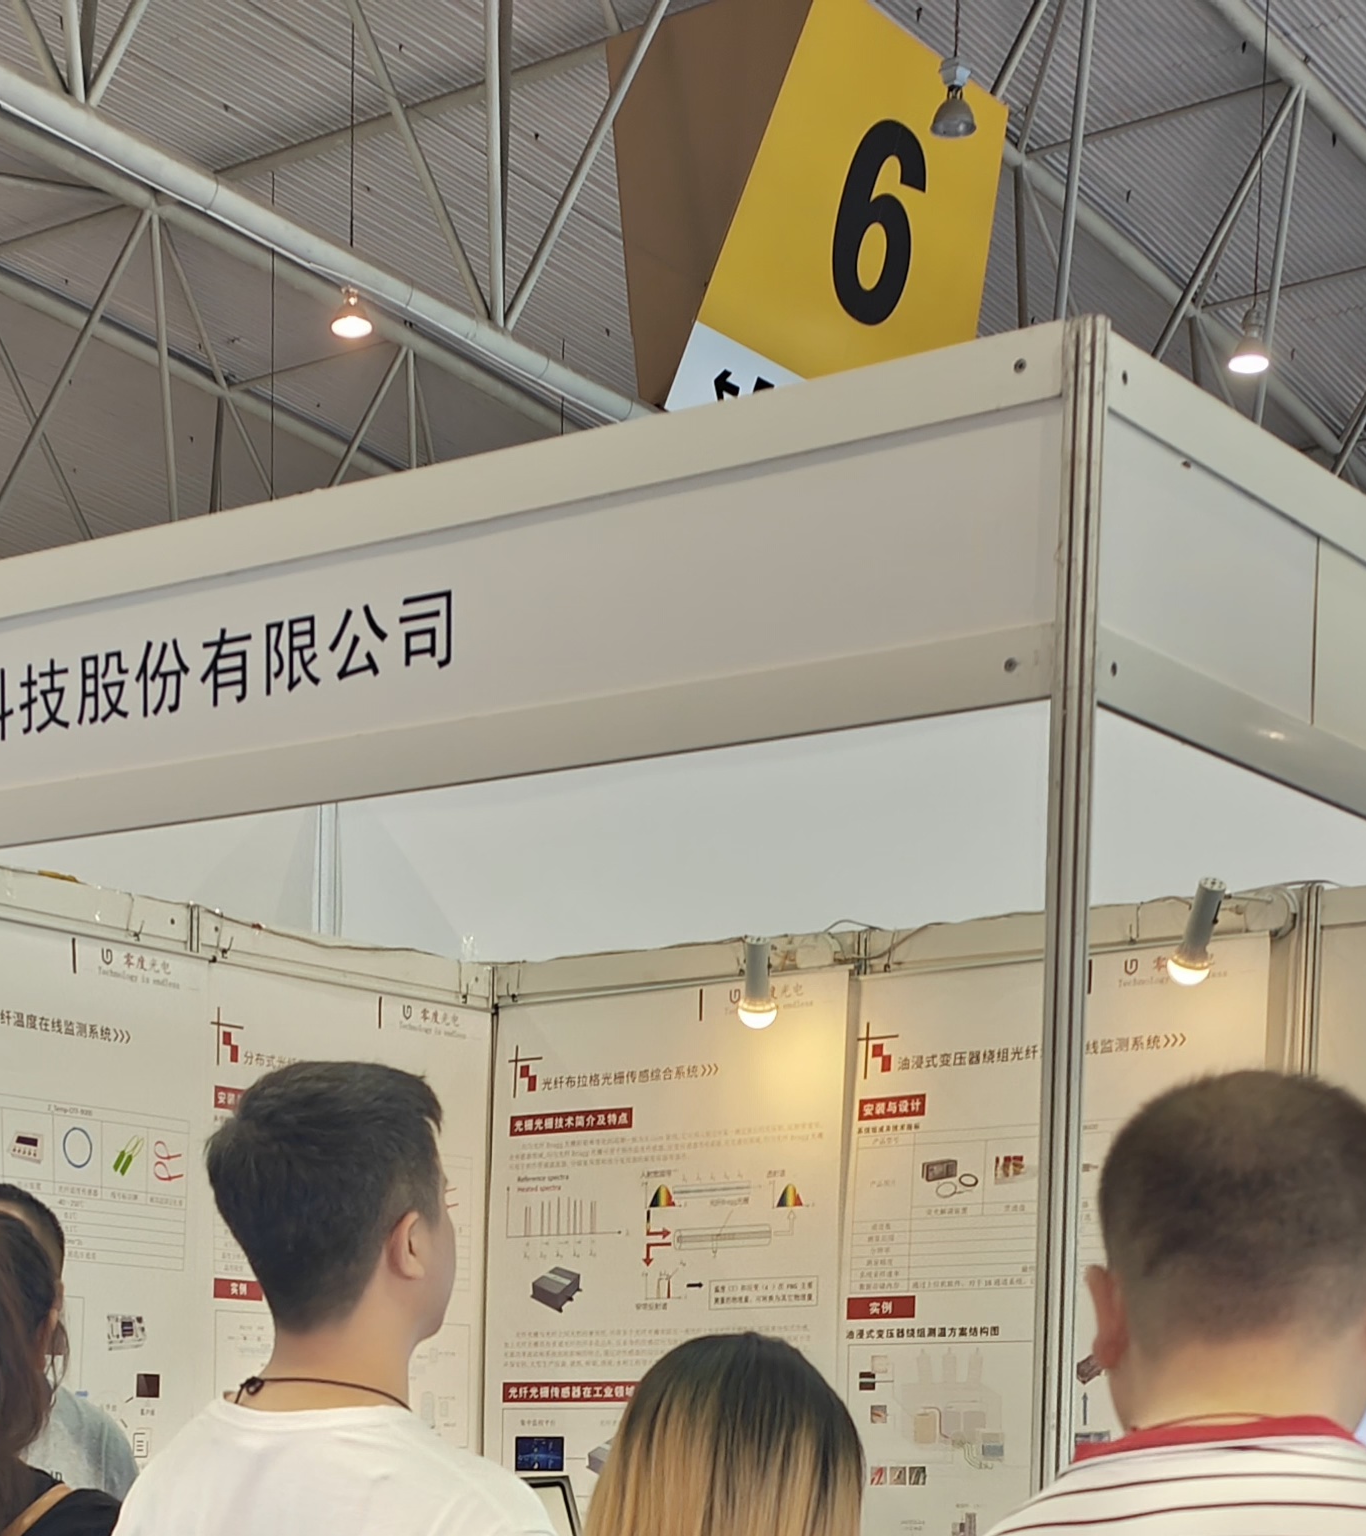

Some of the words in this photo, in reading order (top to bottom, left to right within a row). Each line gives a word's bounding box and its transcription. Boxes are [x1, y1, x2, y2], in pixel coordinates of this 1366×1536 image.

[833, 119, 927, 325] 6
[123, 952, 171, 975] 零度光电
[98, 966, 138, 983] Technology
[1086, 1034, 1161, 1055] 线监测系统
[898, 1044, 1038, 1072] 油浸式变压器绕组光纤
[541, 1064, 699, 1091] 光纤布拉格光栅传感综合系统
[863, 1099, 922, 1117] 安装与设计
[230, 1282, 247, 1296] 实例
[869, 1301, 893, 1315] 实例
[845, 1326, 1000, 1340] 油浸式变压器绕组测温方案结构图
